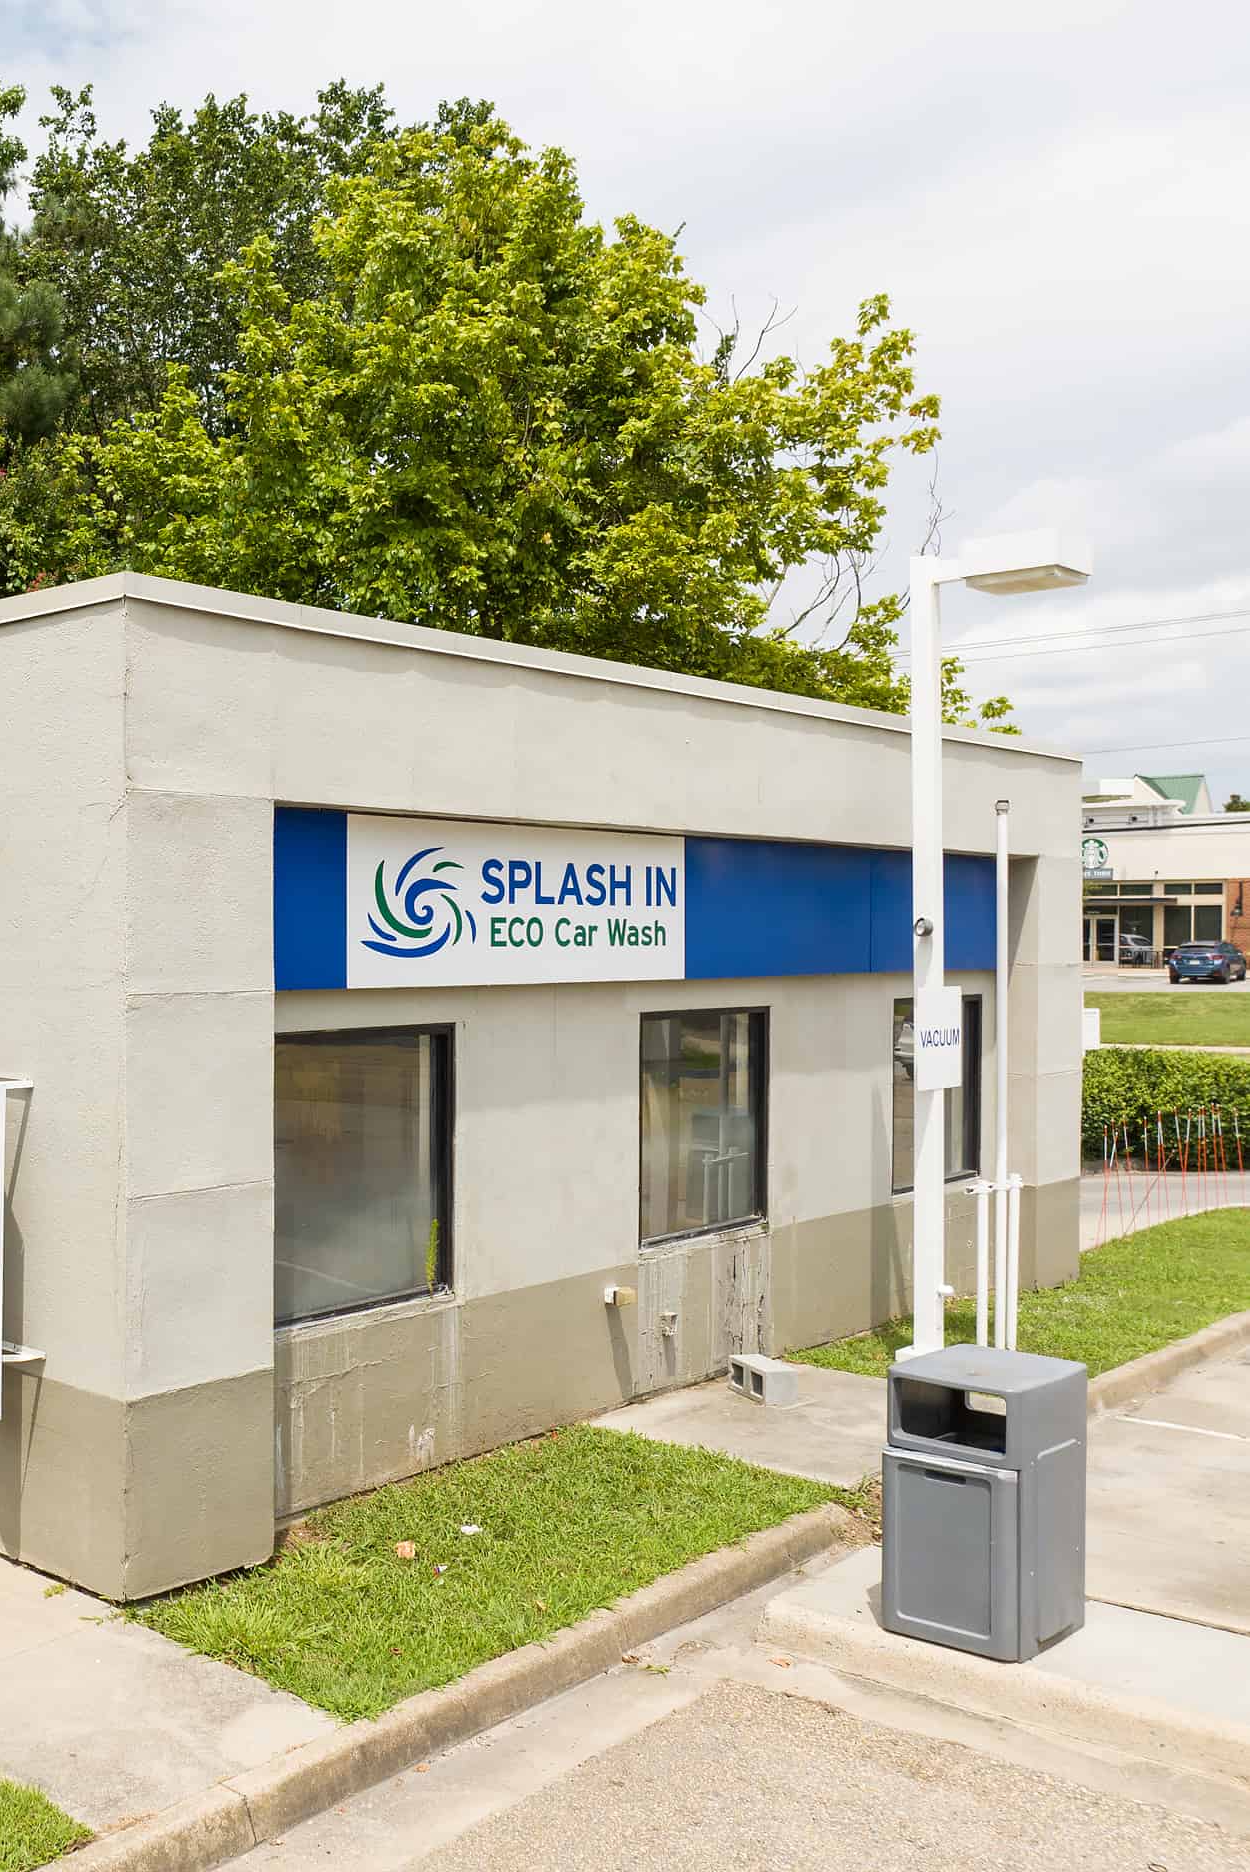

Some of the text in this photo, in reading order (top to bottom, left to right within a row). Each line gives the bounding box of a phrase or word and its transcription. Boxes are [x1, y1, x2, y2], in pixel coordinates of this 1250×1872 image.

[480, 858, 677, 907] SPLASH IN
[490, 916, 667, 948] ECO Car Wash
[920, 1027, 960, 1049] VACUUM
